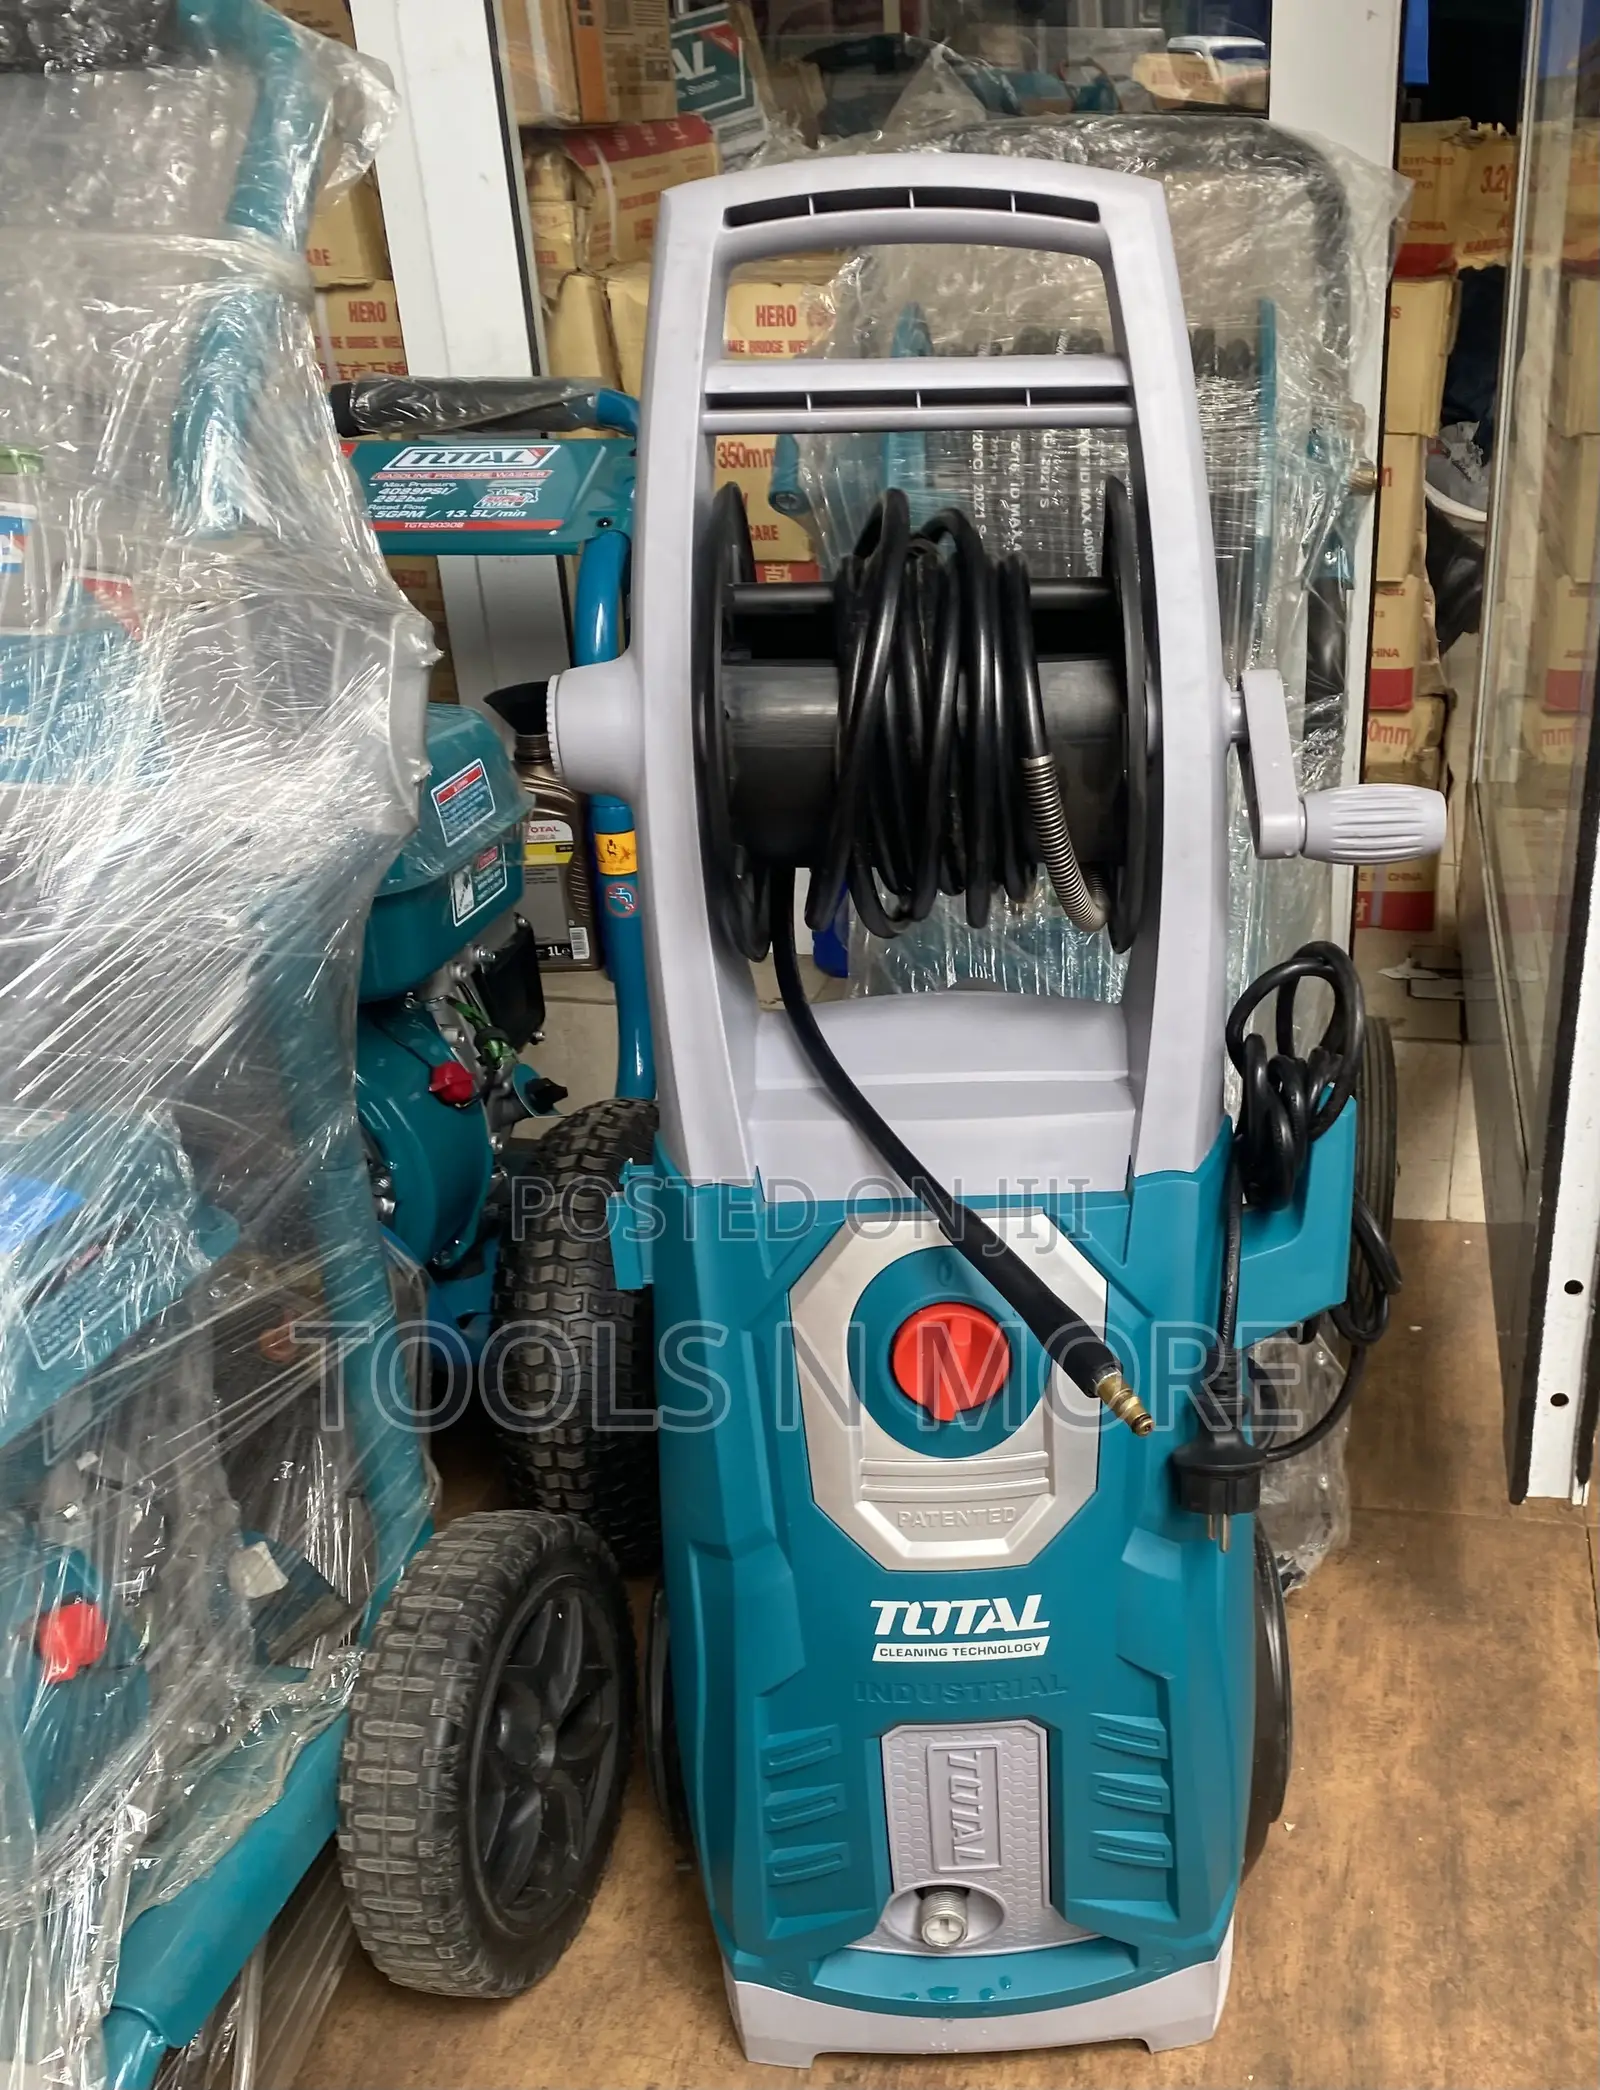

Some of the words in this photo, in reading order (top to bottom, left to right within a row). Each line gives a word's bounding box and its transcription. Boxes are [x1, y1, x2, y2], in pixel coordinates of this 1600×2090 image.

[670, 40, 717, 80] AL
[348, 301, 387, 323] HERO
[755, 304, 797, 327] HERO
[410, 451, 528, 465] TOTAL
[1079, 467, 1092, 483] ID
[1080, 487, 1093, 525] MAX
[1371, 648, 1400, 658] HINA
[897, 1506, 1018, 1529] PATENTED
[869, 1594, 1051, 1636] TOTAL
[879, 1647, 949, 1657] CLEANING
[953, 1641, 1042, 1657] TECHNOLOGY
[852, 1673, 1070, 1705] INDUSTRIAL
[947, 1751, 987, 1865] TOTAL
